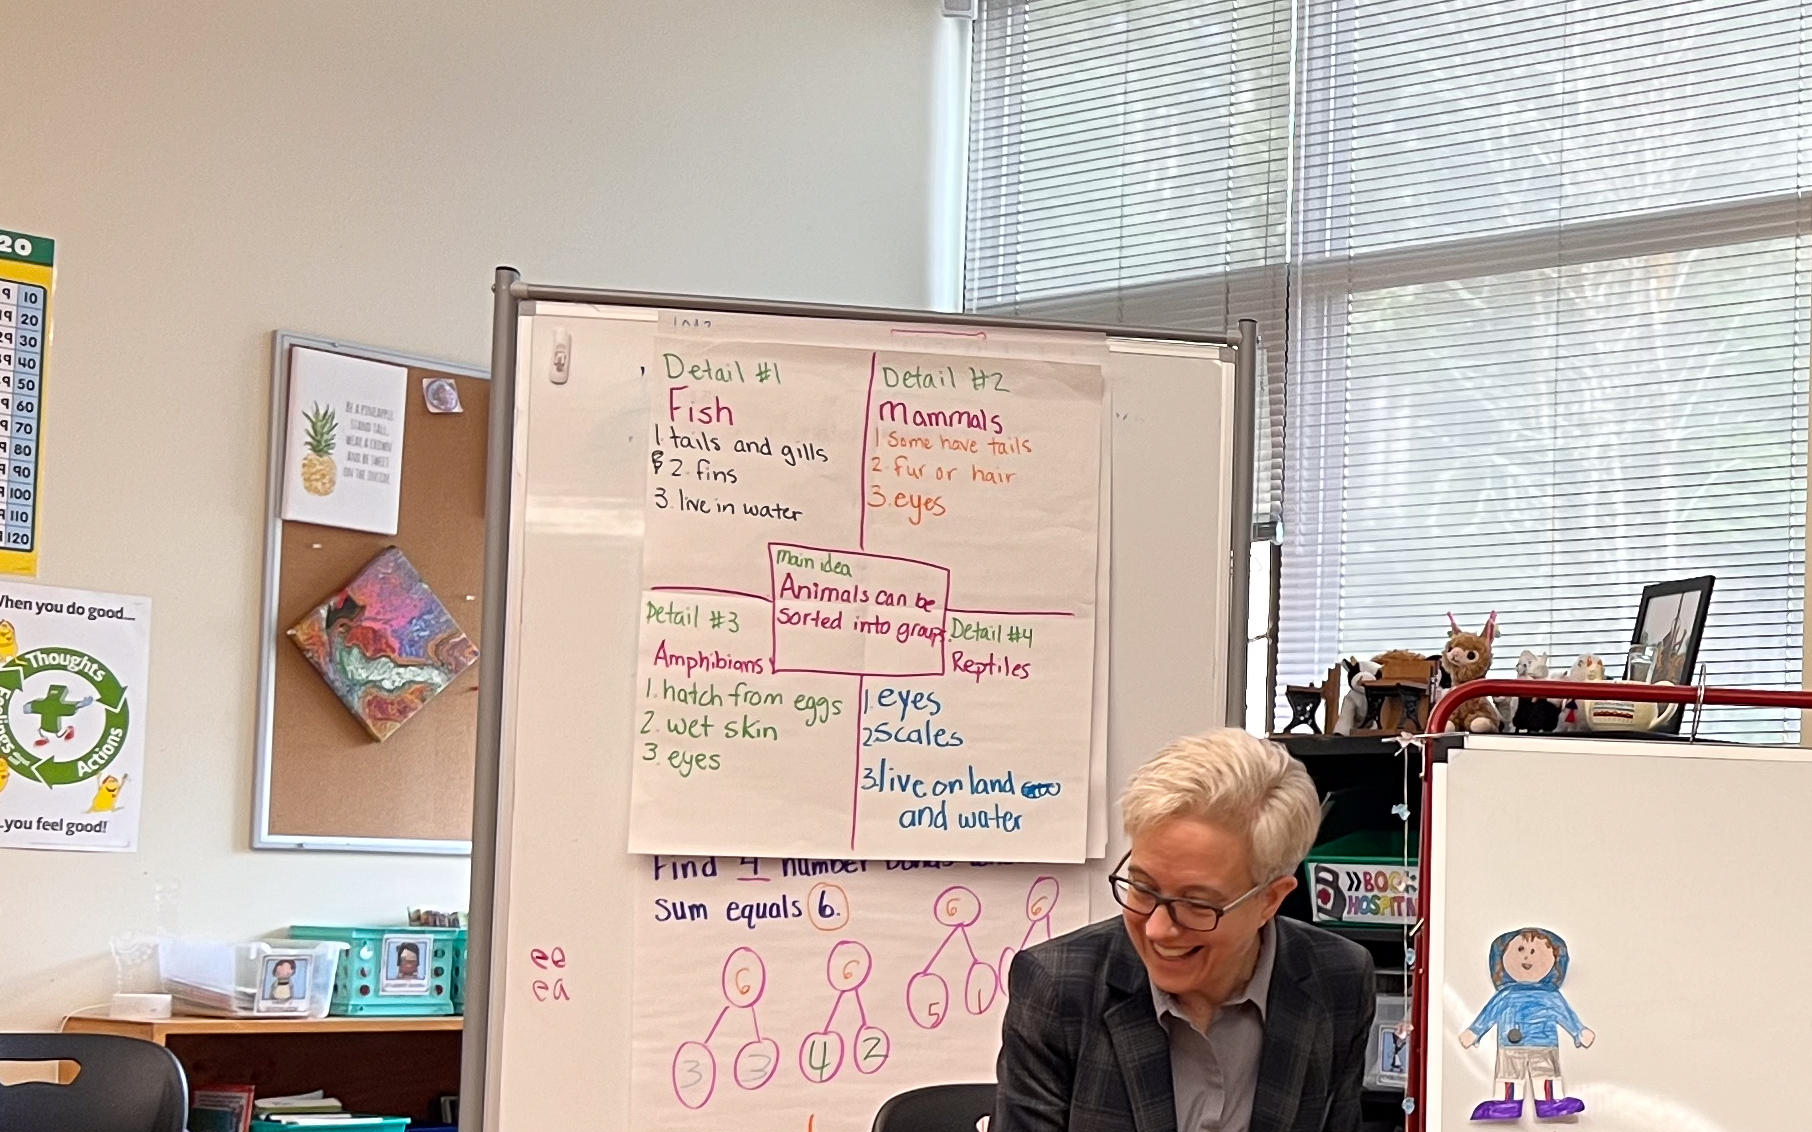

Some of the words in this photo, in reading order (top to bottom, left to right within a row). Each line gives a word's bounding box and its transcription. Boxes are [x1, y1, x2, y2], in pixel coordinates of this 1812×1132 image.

[24, 291, 38, 304] 10
[21, 313, 38, 326] 20
[19, 335, 37, 347] 30
[18, 357, 36, 370] 40
[663, 353, 744, 383] Detail
[755, 362, 781, 384] #1
[17, 378, 35, 391] 50
[882, 366, 956, 389] Detail
[969, 367, 1011, 393] #2
[16, 401, 34, 413] 60
[669, 385, 733, 426] Fish
[879, 400, 1003, 434] Mammals
[15, 422, 33, 435] 70
[14, 444, 32, 456] 80
[669, 426, 721, 451] tails
[734, 437, 773, 456] and
[781, 443, 828, 466] gills
[940, 434, 979, 454] have
[987, 437, 1032, 455] tails
[13, 465, 31, 478] 90
[697, 459, 738, 484] fins
[894, 455, 926, 479] fur
[936, 467, 957, 481] or
[972, 464, 1016, 484] hair
[9, 488, 31, 500] 100
[679, 489, 711, 513] live
[717, 498, 735, 515] in
[744, 503, 803, 521] water
[10, 510, 29, 523] 110
[894, 492, 946, 525] eyes
[7, 532, 30, 545] 120
[820, 553, 853, 577] idea
[780, 572, 869, 603] Animals
[875, 589, 907, 607] can
[915, 593, 936, 612] be
[35, 601, 63, 615] you
[67, 602, 85, 615] do
[646, 600, 699, 628] Detail
[709, 611, 740, 633] #3
[854, 618, 890, 634] into
[950, 617, 1002, 643] Detail
[1007, 626, 1033, 648] #4
[25, 651, 106, 681] Thoughts
[654, 639, 764, 678] Amphibians
[952, 650, 1032, 683] Reptiles
[663, 679, 723, 707] hatch
[728, 682, 783, 707] from
[794, 694, 843, 727] eggs
[877, 688, 941, 721] eyes
[667, 715, 714, 739] wet
[725, 715, 778, 741] skin
[76, 727, 123, 777] Actions
[667, 750, 721, 778] eyes
[932, 779, 963, 797] on
[969, 765, 1015, 795] land
[37, 816, 63, 831] feel
[66, 821, 108, 836] good!
[899, 800, 948, 831] and
[958, 803, 1023, 832] water
[726, 895, 803, 930] equals
[946, 897, 961, 917] 6
[1031, 895, 1048, 917] 6
[530, 946, 566, 970] ee
[842, 959, 861, 981] 6
[532, 978, 570, 1002] ea
[735, 967, 751, 995] 6
[809, 1040, 831, 1082] 4
[863, 1037, 889, 1061] 2
[681, 1060, 702, 1089] 3
[741, 1053, 771, 1082] 3
